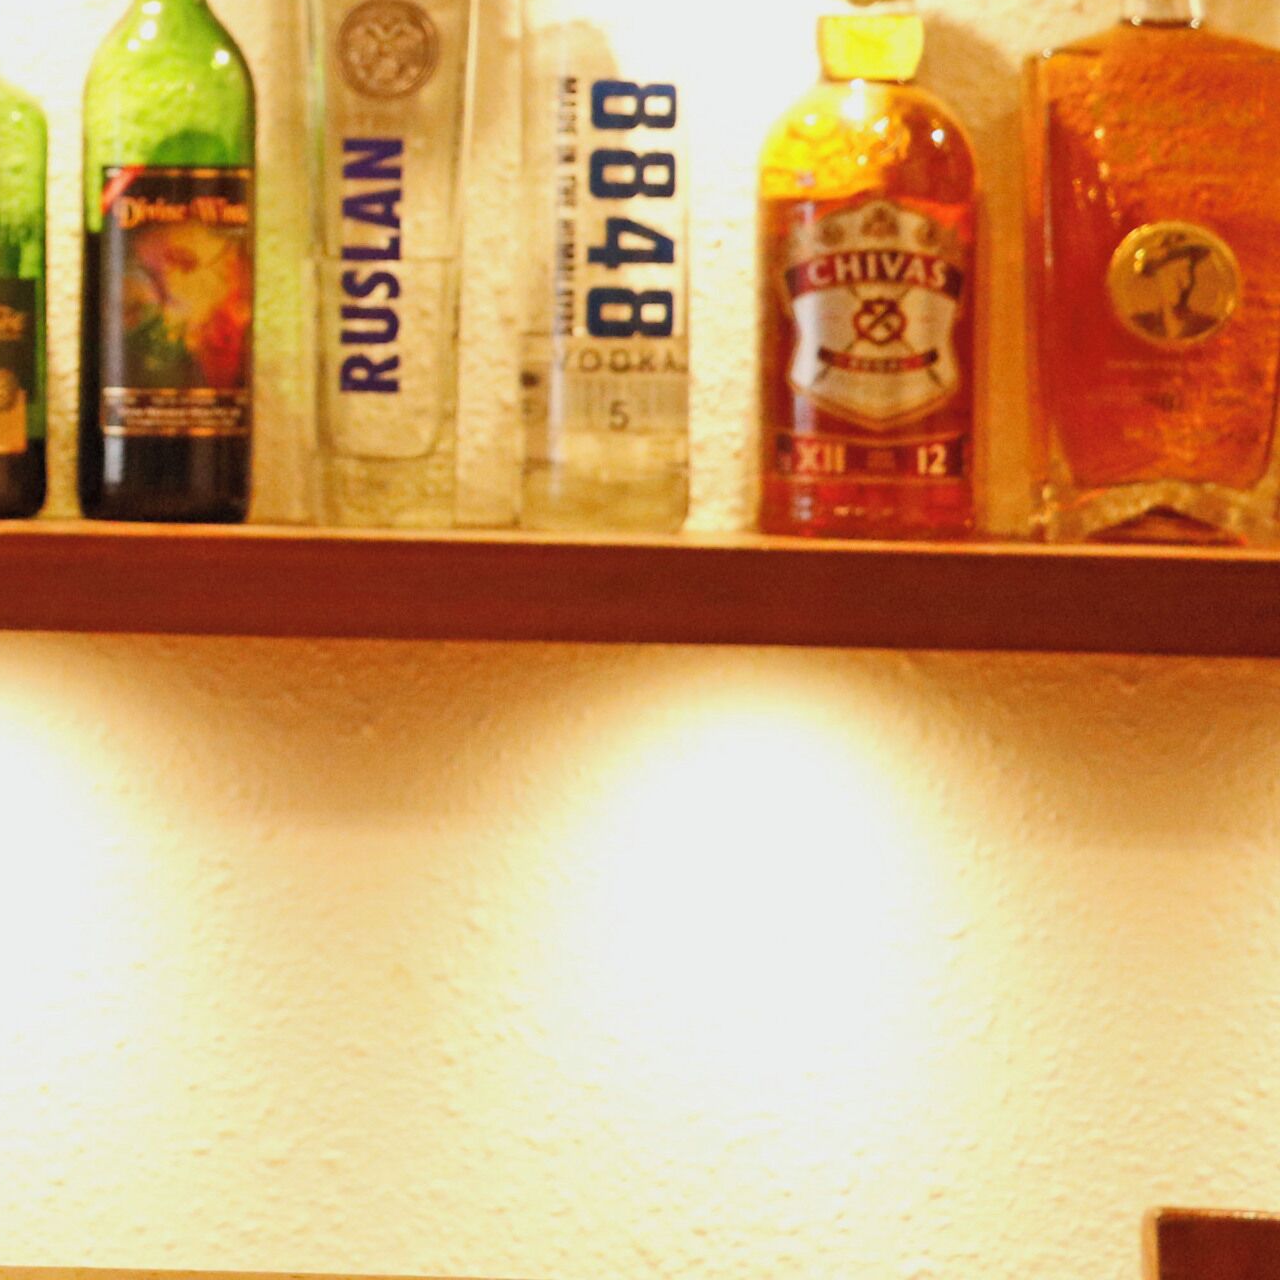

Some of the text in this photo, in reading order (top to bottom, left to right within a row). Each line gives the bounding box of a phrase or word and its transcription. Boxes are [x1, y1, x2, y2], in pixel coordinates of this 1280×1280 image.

[340, 138, 404, 393] RUSLAN
[586, 80, 676, 337] 8848
[806, 253, 948, 288] CHIVAS
[916, 442, 948, 476] 12
